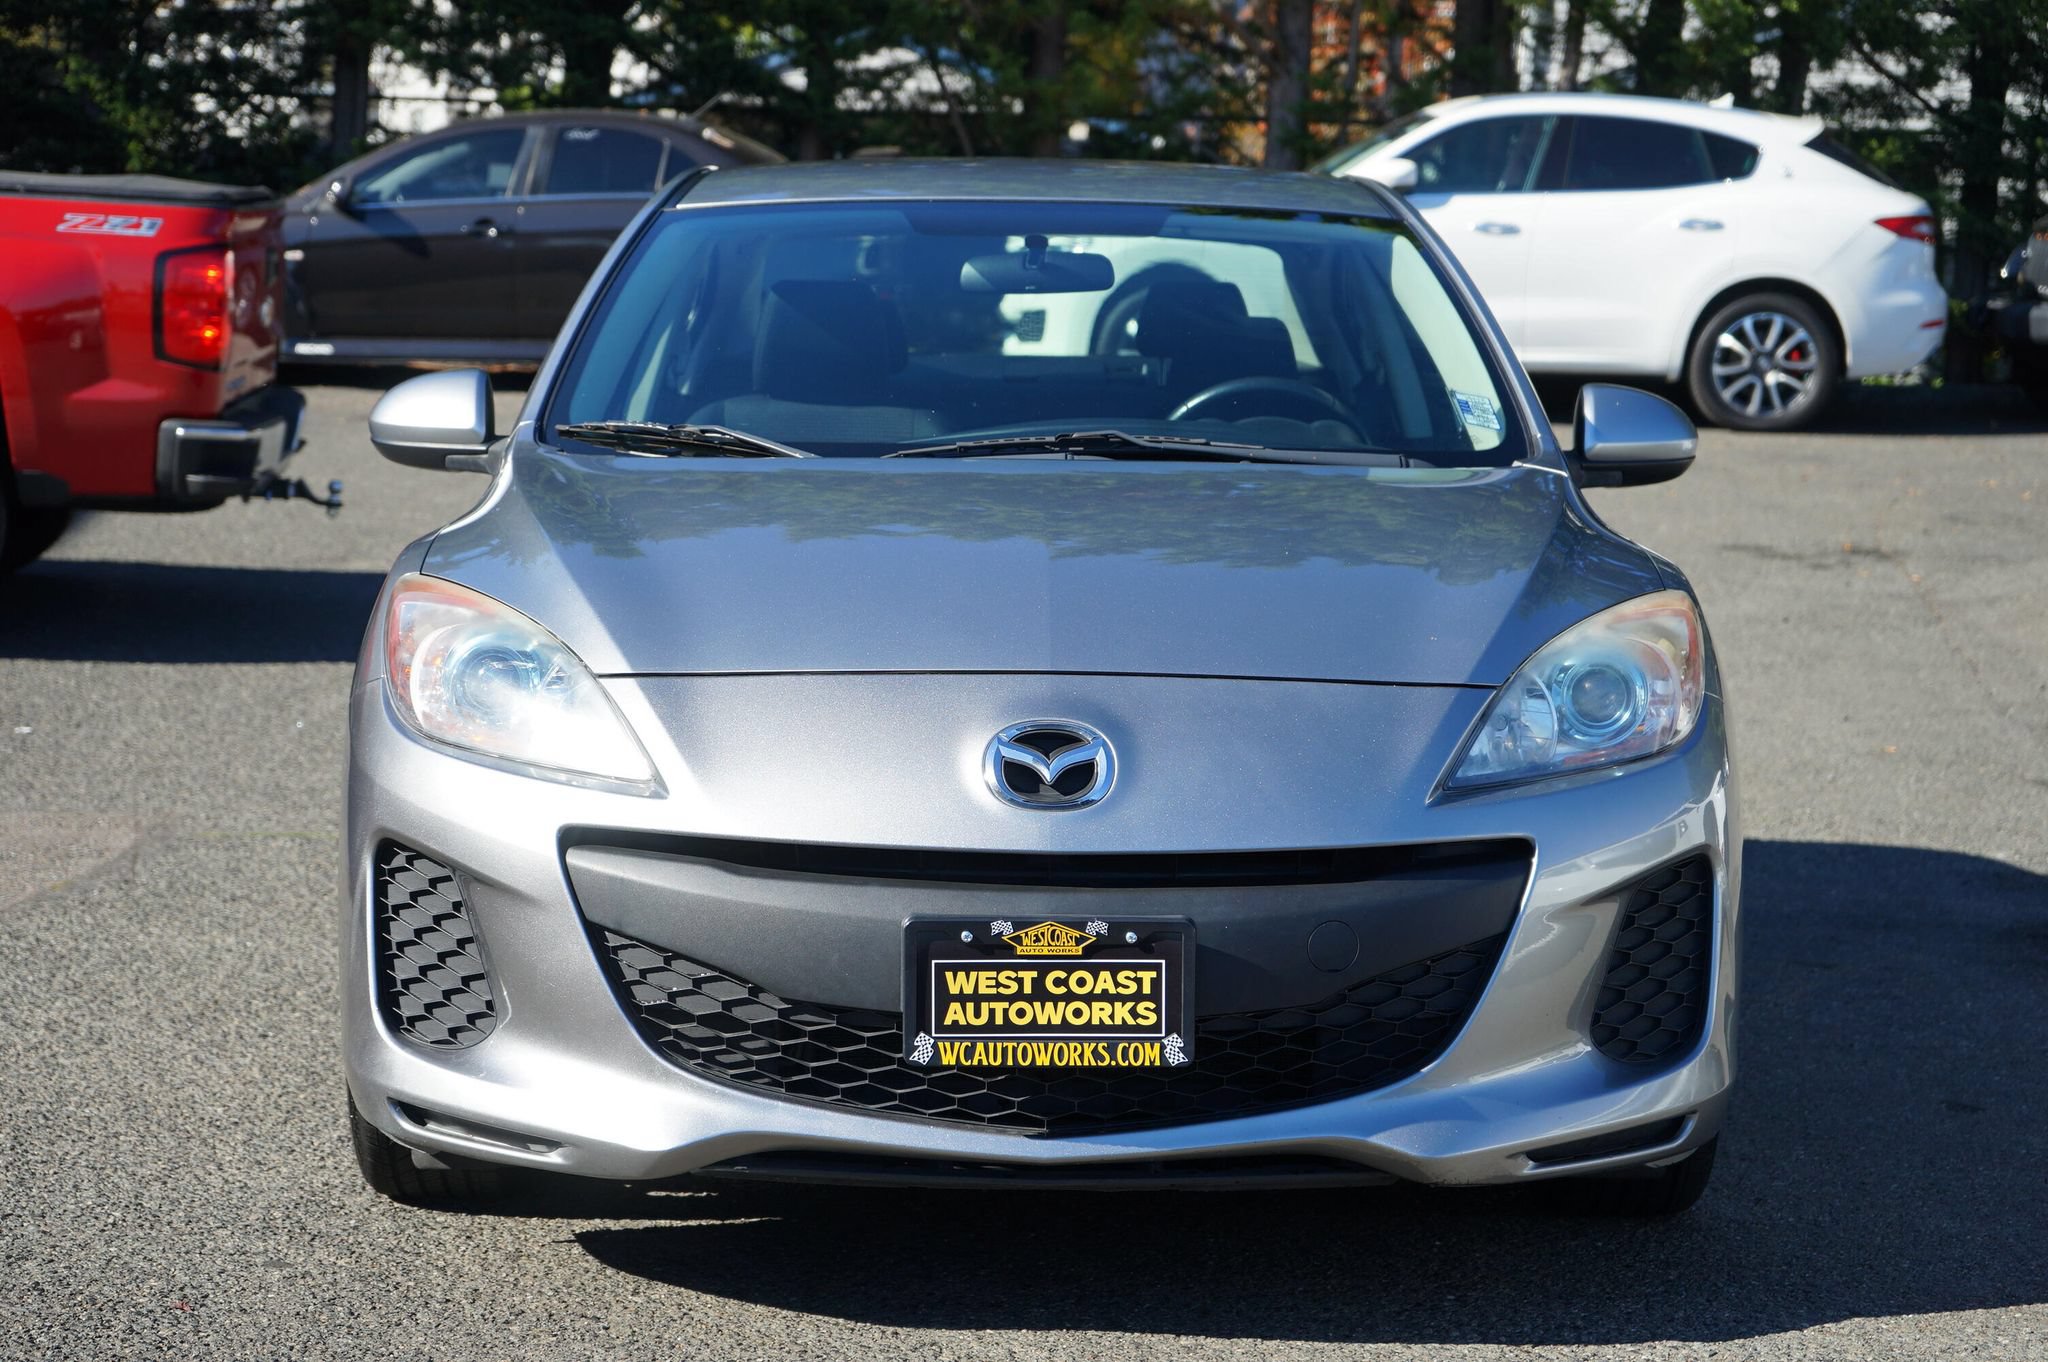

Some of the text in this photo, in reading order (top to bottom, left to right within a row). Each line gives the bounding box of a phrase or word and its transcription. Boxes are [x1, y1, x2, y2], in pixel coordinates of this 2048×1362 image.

[1020, 925, 1080, 946] WEST COAST
[945, 970, 1157, 995] WEST COAST
[943, 1001, 1158, 1026] AUTOWORKS
[938, 1041, 1161, 1066] WCAUTOWORKS.COM
